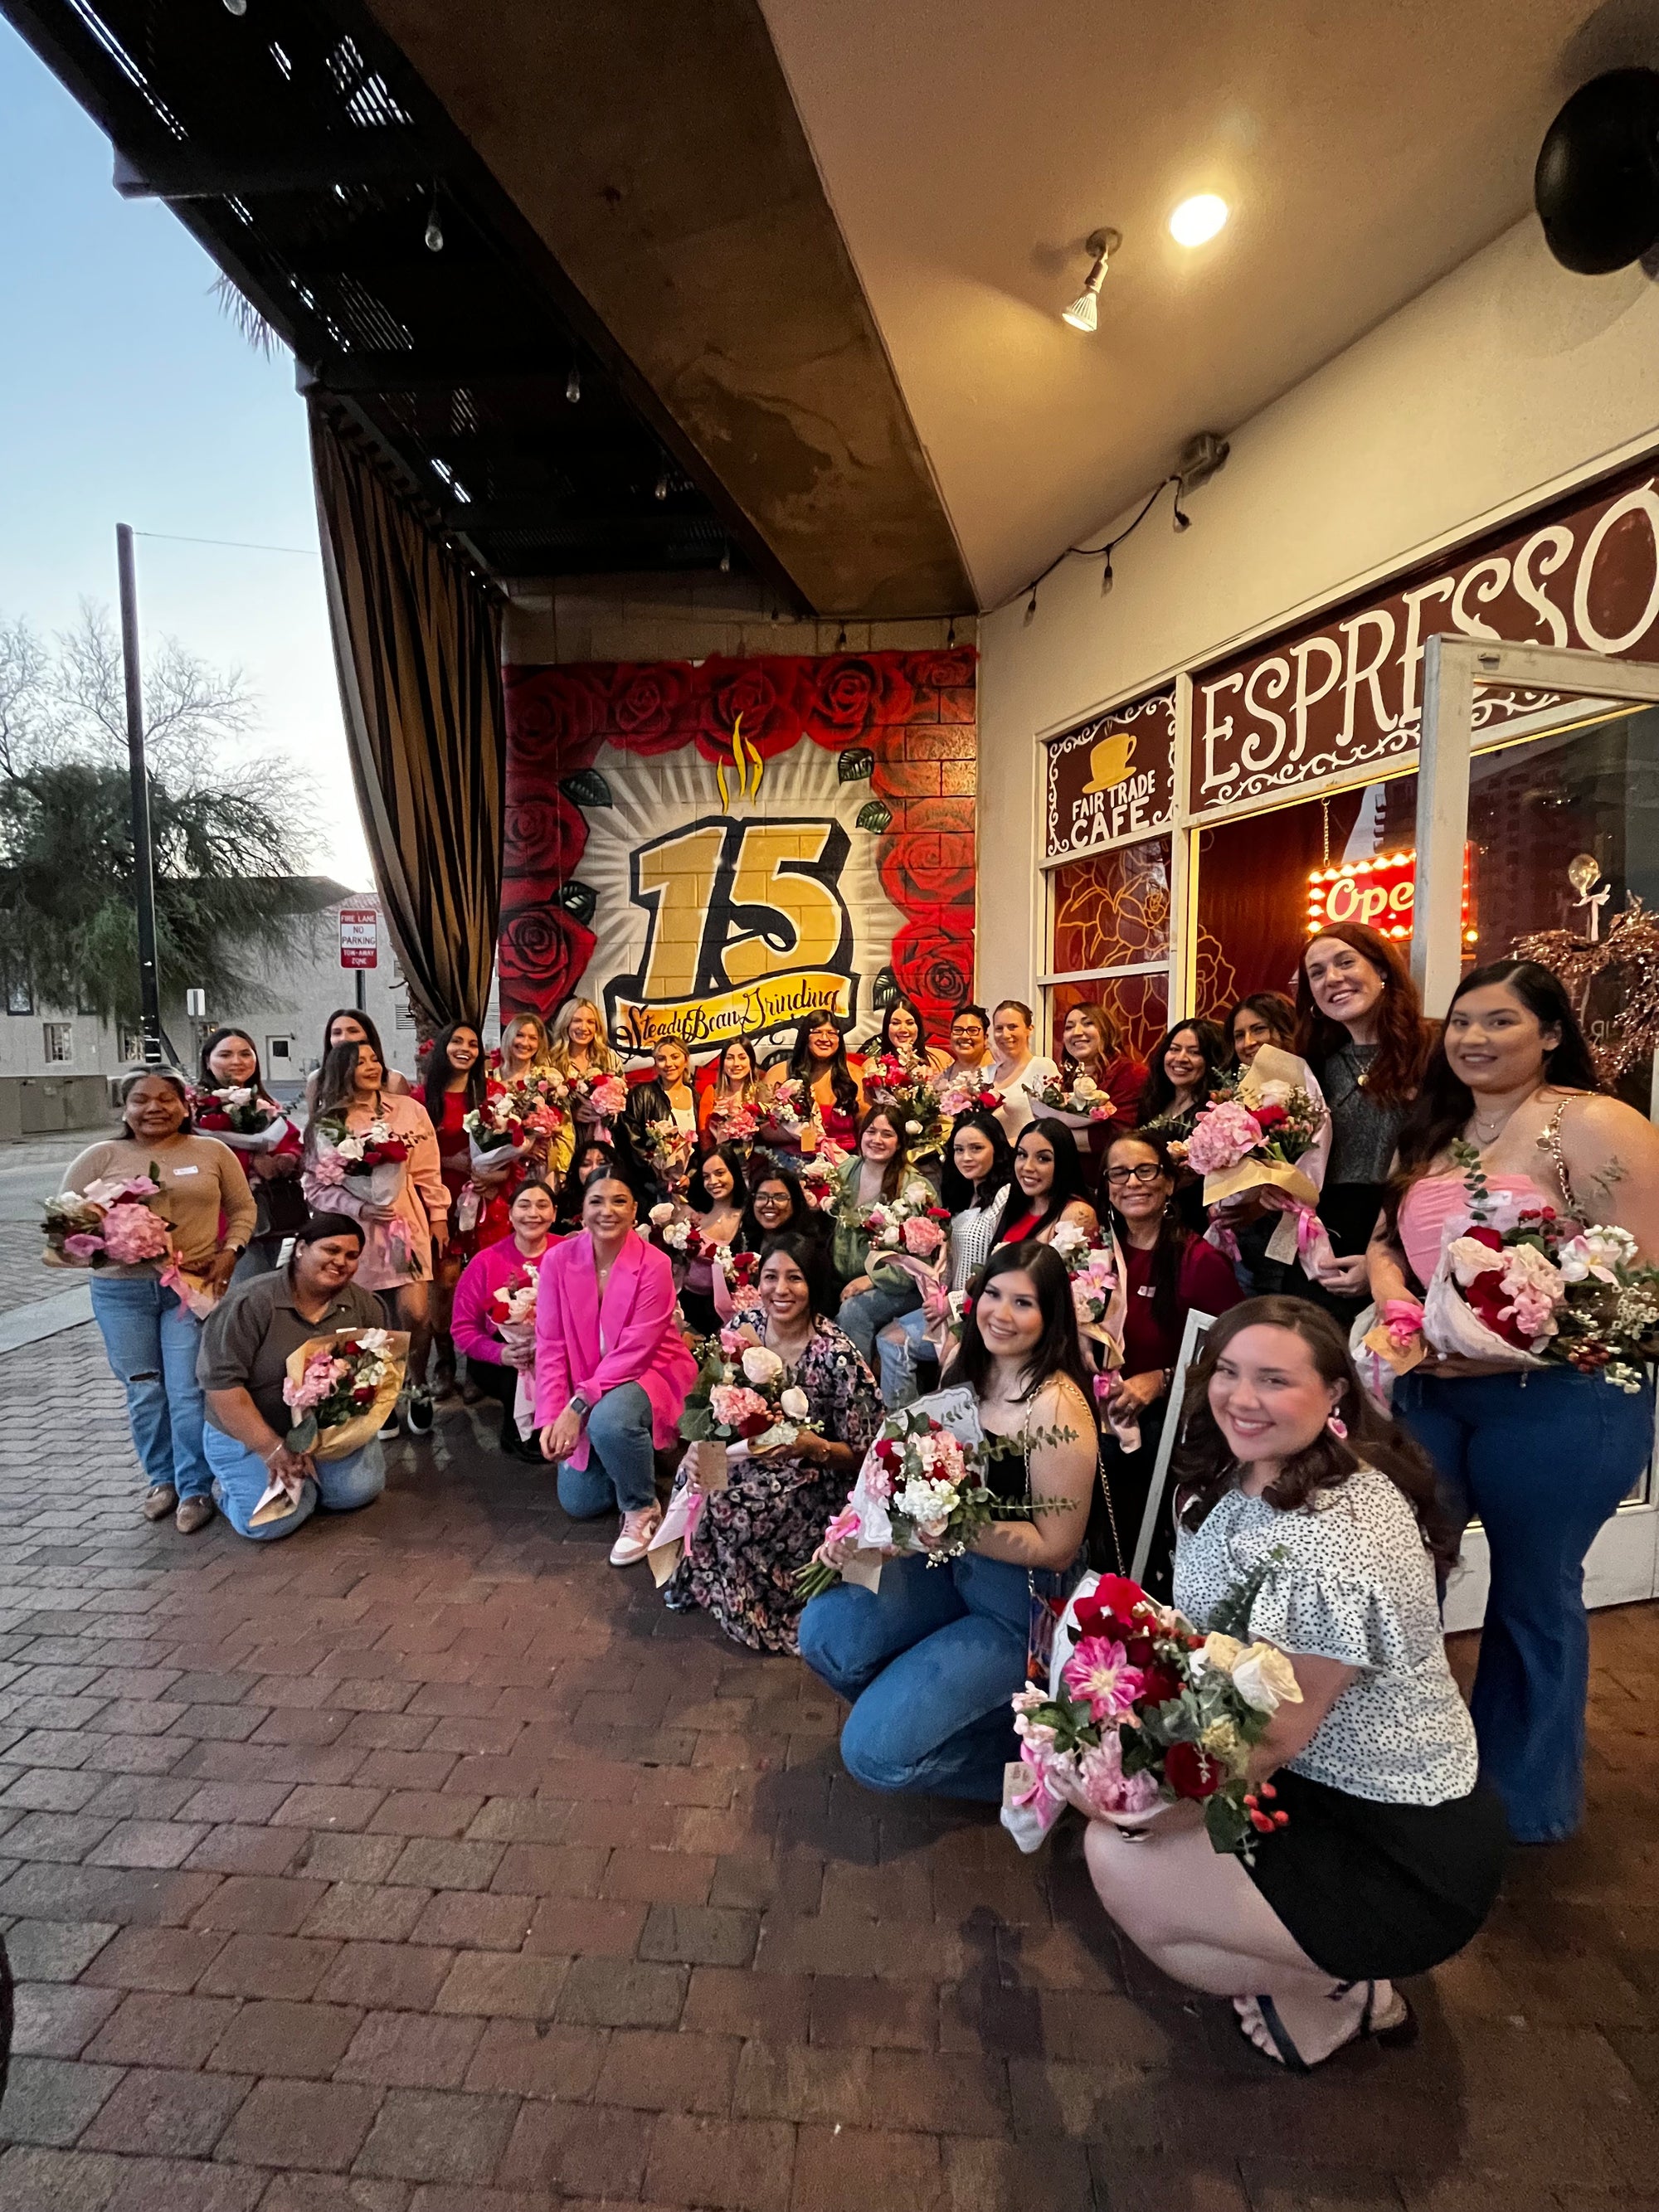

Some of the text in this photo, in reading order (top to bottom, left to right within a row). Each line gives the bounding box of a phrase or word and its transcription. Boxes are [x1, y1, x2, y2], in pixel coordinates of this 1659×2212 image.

[1072, 770, 1155, 821] FAIR TRADE
[1070, 795, 1150, 848] CAFE
[341, 915, 355, 923] FIRE
[637, 823, 844, 999] 15
[1326, 878, 1415, 925] Ope
[342, 936, 376, 945] PARKING
[353, 926, 364, 934] NO
